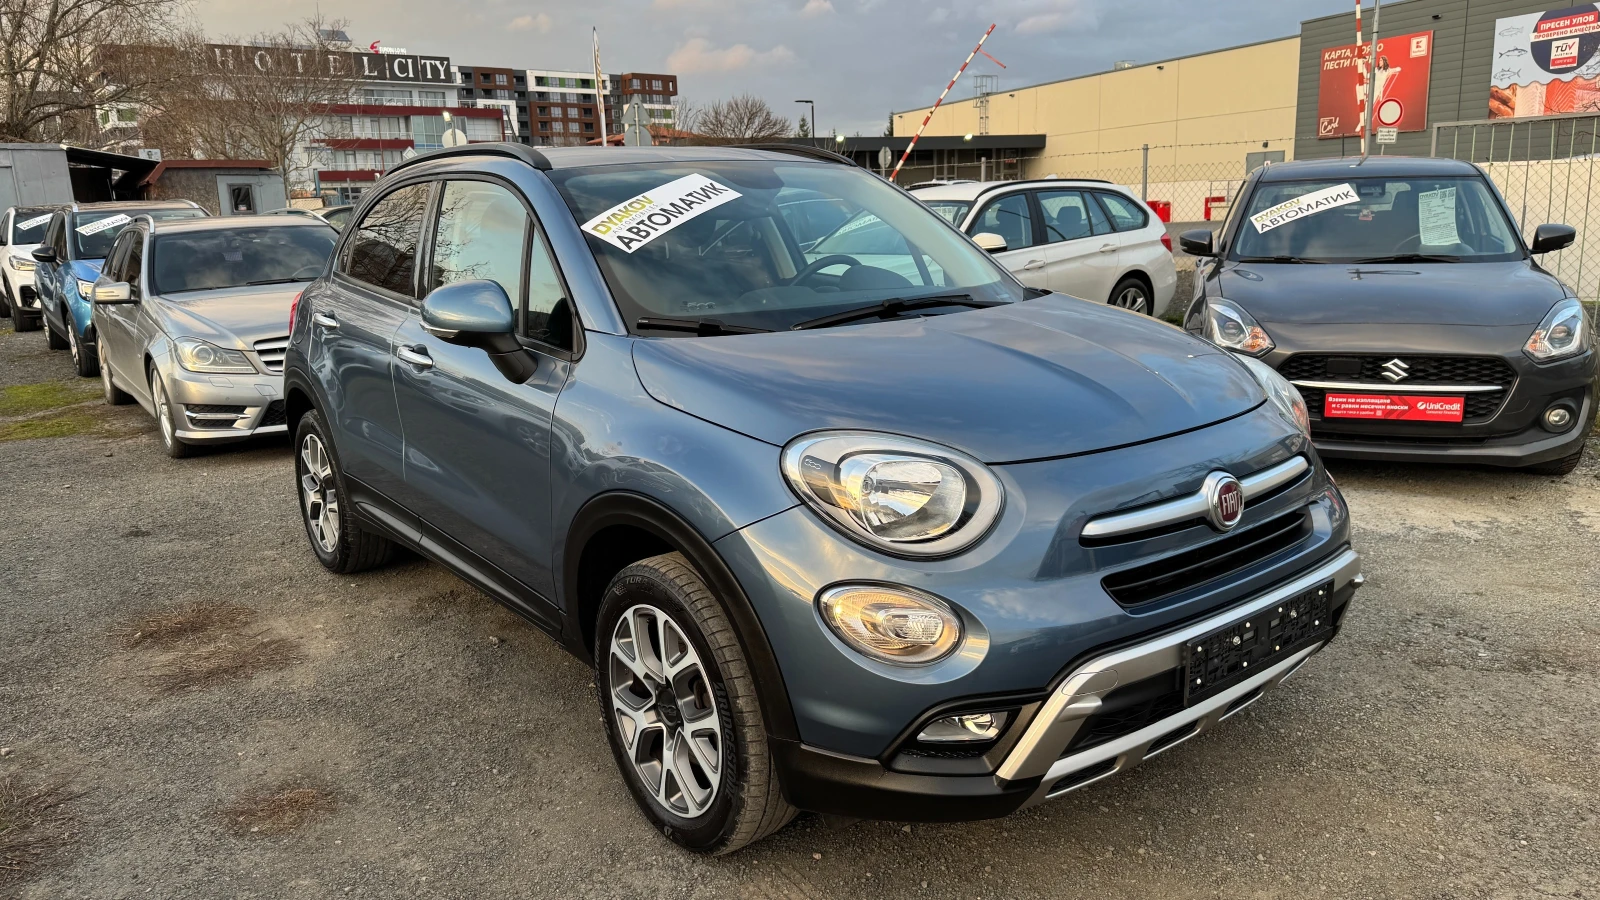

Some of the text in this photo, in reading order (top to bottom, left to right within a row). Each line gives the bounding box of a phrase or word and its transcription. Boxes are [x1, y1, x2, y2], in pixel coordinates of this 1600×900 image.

[1540, 14, 1595, 31] ПРЕСЕН УЛОВ
[1534, 30, 1568, 40] ПРОВЕРЕНО
[214, 47, 447, 79] HOTEL CITY
[1324, 49, 1352, 60] КАРТА,
[1324, 59, 1350, 70] ПЕСТИ
[1321, 117, 1339, 133] Card
[592, 195, 655, 235] DYAKOV
[612, 203, 659, 235] AUTOMOBILES
[616, 182, 729, 250] АВТОМАТИК
[1255, 199, 1301, 223] DYAKOV
[1260, 190, 1355, 232] АВТОМАТИК
[1426, 402, 1461, 411] UniCredit
[1222, 491, 1238, 515] FIAT
